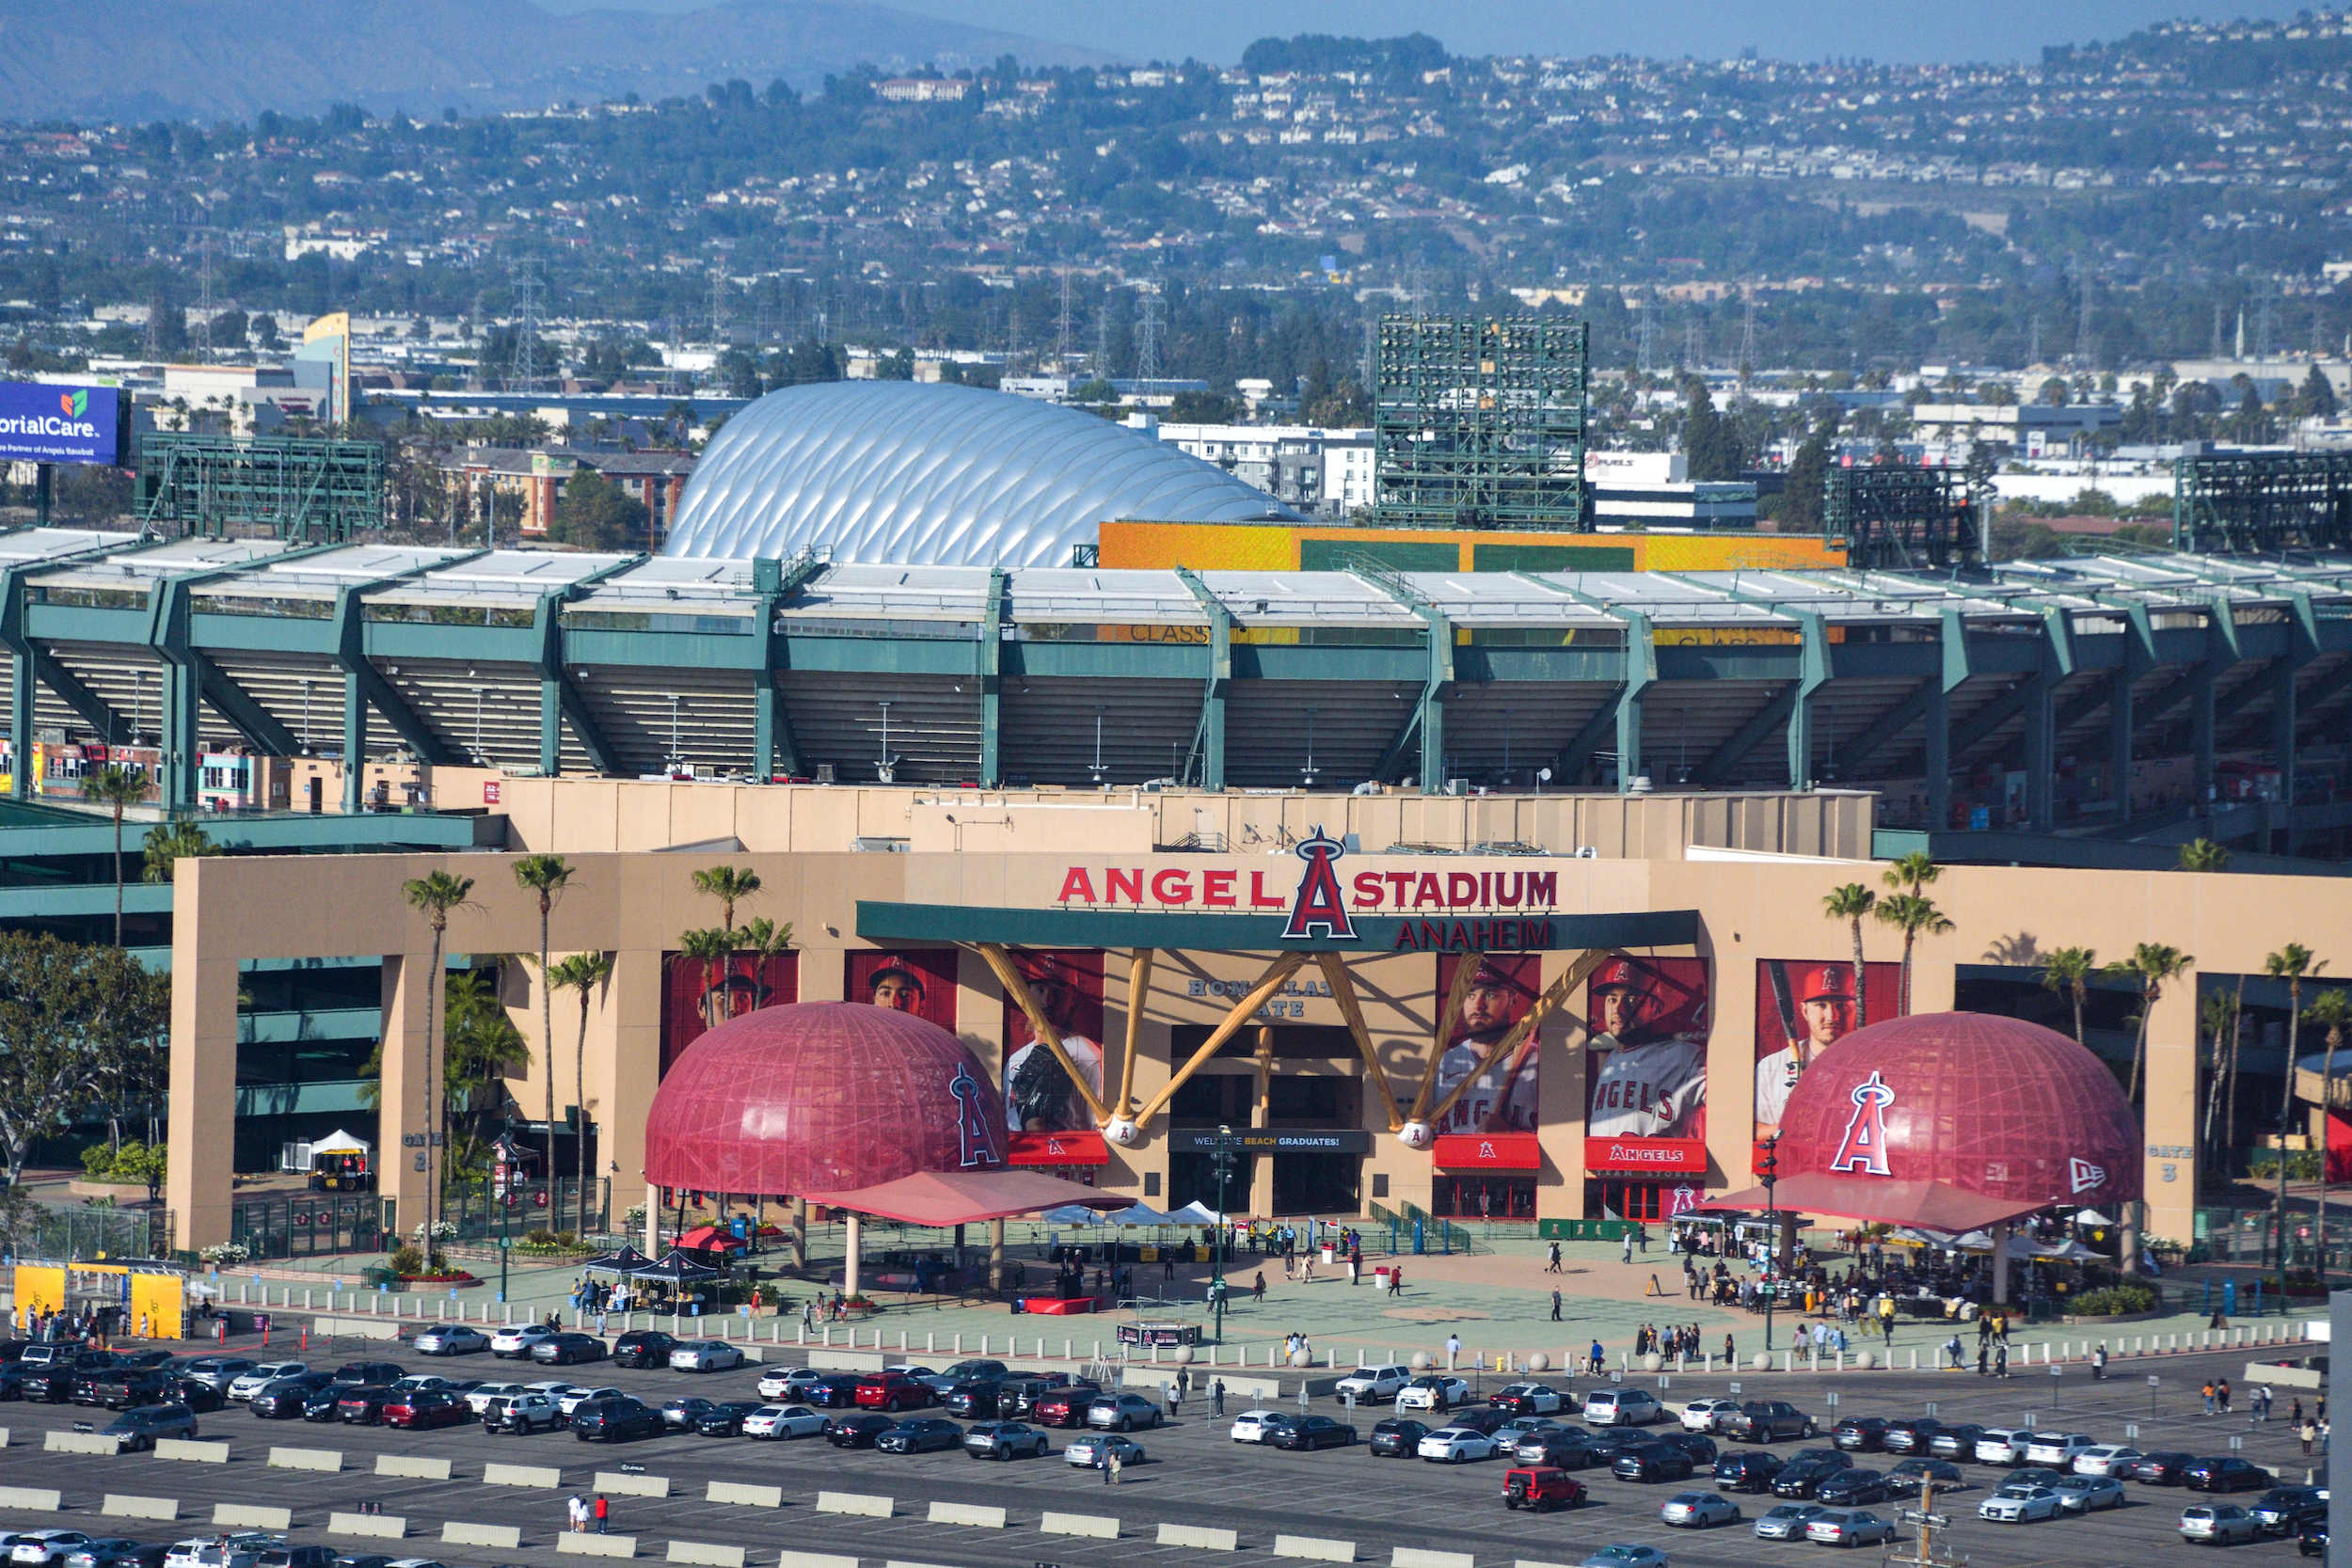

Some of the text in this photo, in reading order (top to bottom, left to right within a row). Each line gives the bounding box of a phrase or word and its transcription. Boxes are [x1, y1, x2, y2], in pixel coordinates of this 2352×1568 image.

[8, 444, 33, 453] Partner
[42, 446, 65, 456] Angels
[66, 447, 94, 456] Baseball
[1057, 867, 1286, 908] ANGEL
[1352, 871, 1558, 909] STADIUM
[1394, 918, 1550, 950] ANAHEIM
[1244, 1136, 1277, 1146] BEACH
[1279, 1136, 1340, 1147] GRADUATES!
[1610, 1143, 1684, 1163] ANGELS
[2146, 1145, 2194, 1159] GATE
[2161, 1164, 2177, 1182] 3
